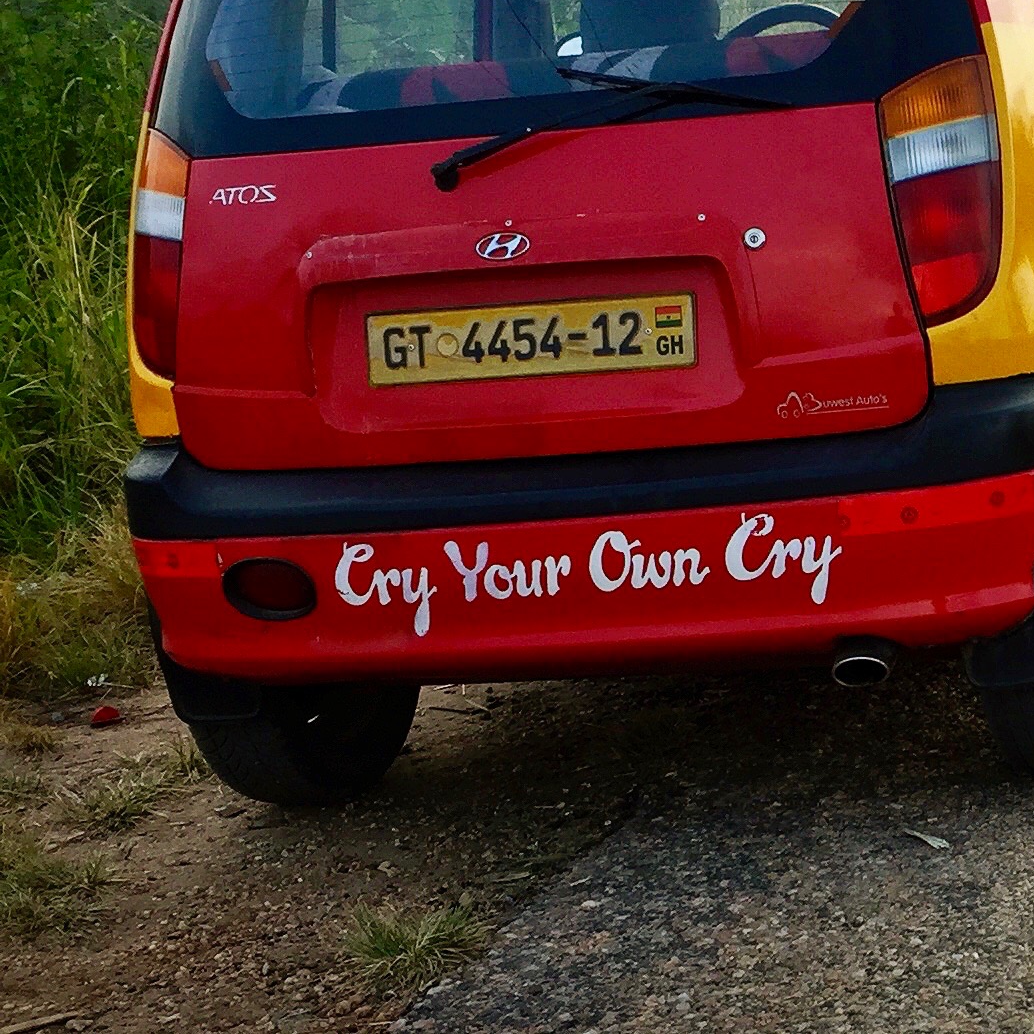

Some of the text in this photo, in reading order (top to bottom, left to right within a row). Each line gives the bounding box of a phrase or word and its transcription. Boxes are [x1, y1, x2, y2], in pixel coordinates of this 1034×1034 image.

[209, 185, 277, 205] ATOS
[383, 311, 643, 370] GT 4454-12
[656, 334, 684, 356] GH
[856, 394, 888, 405] Auto's
[335, 512, 842, 636] Cry Your Own Cry
